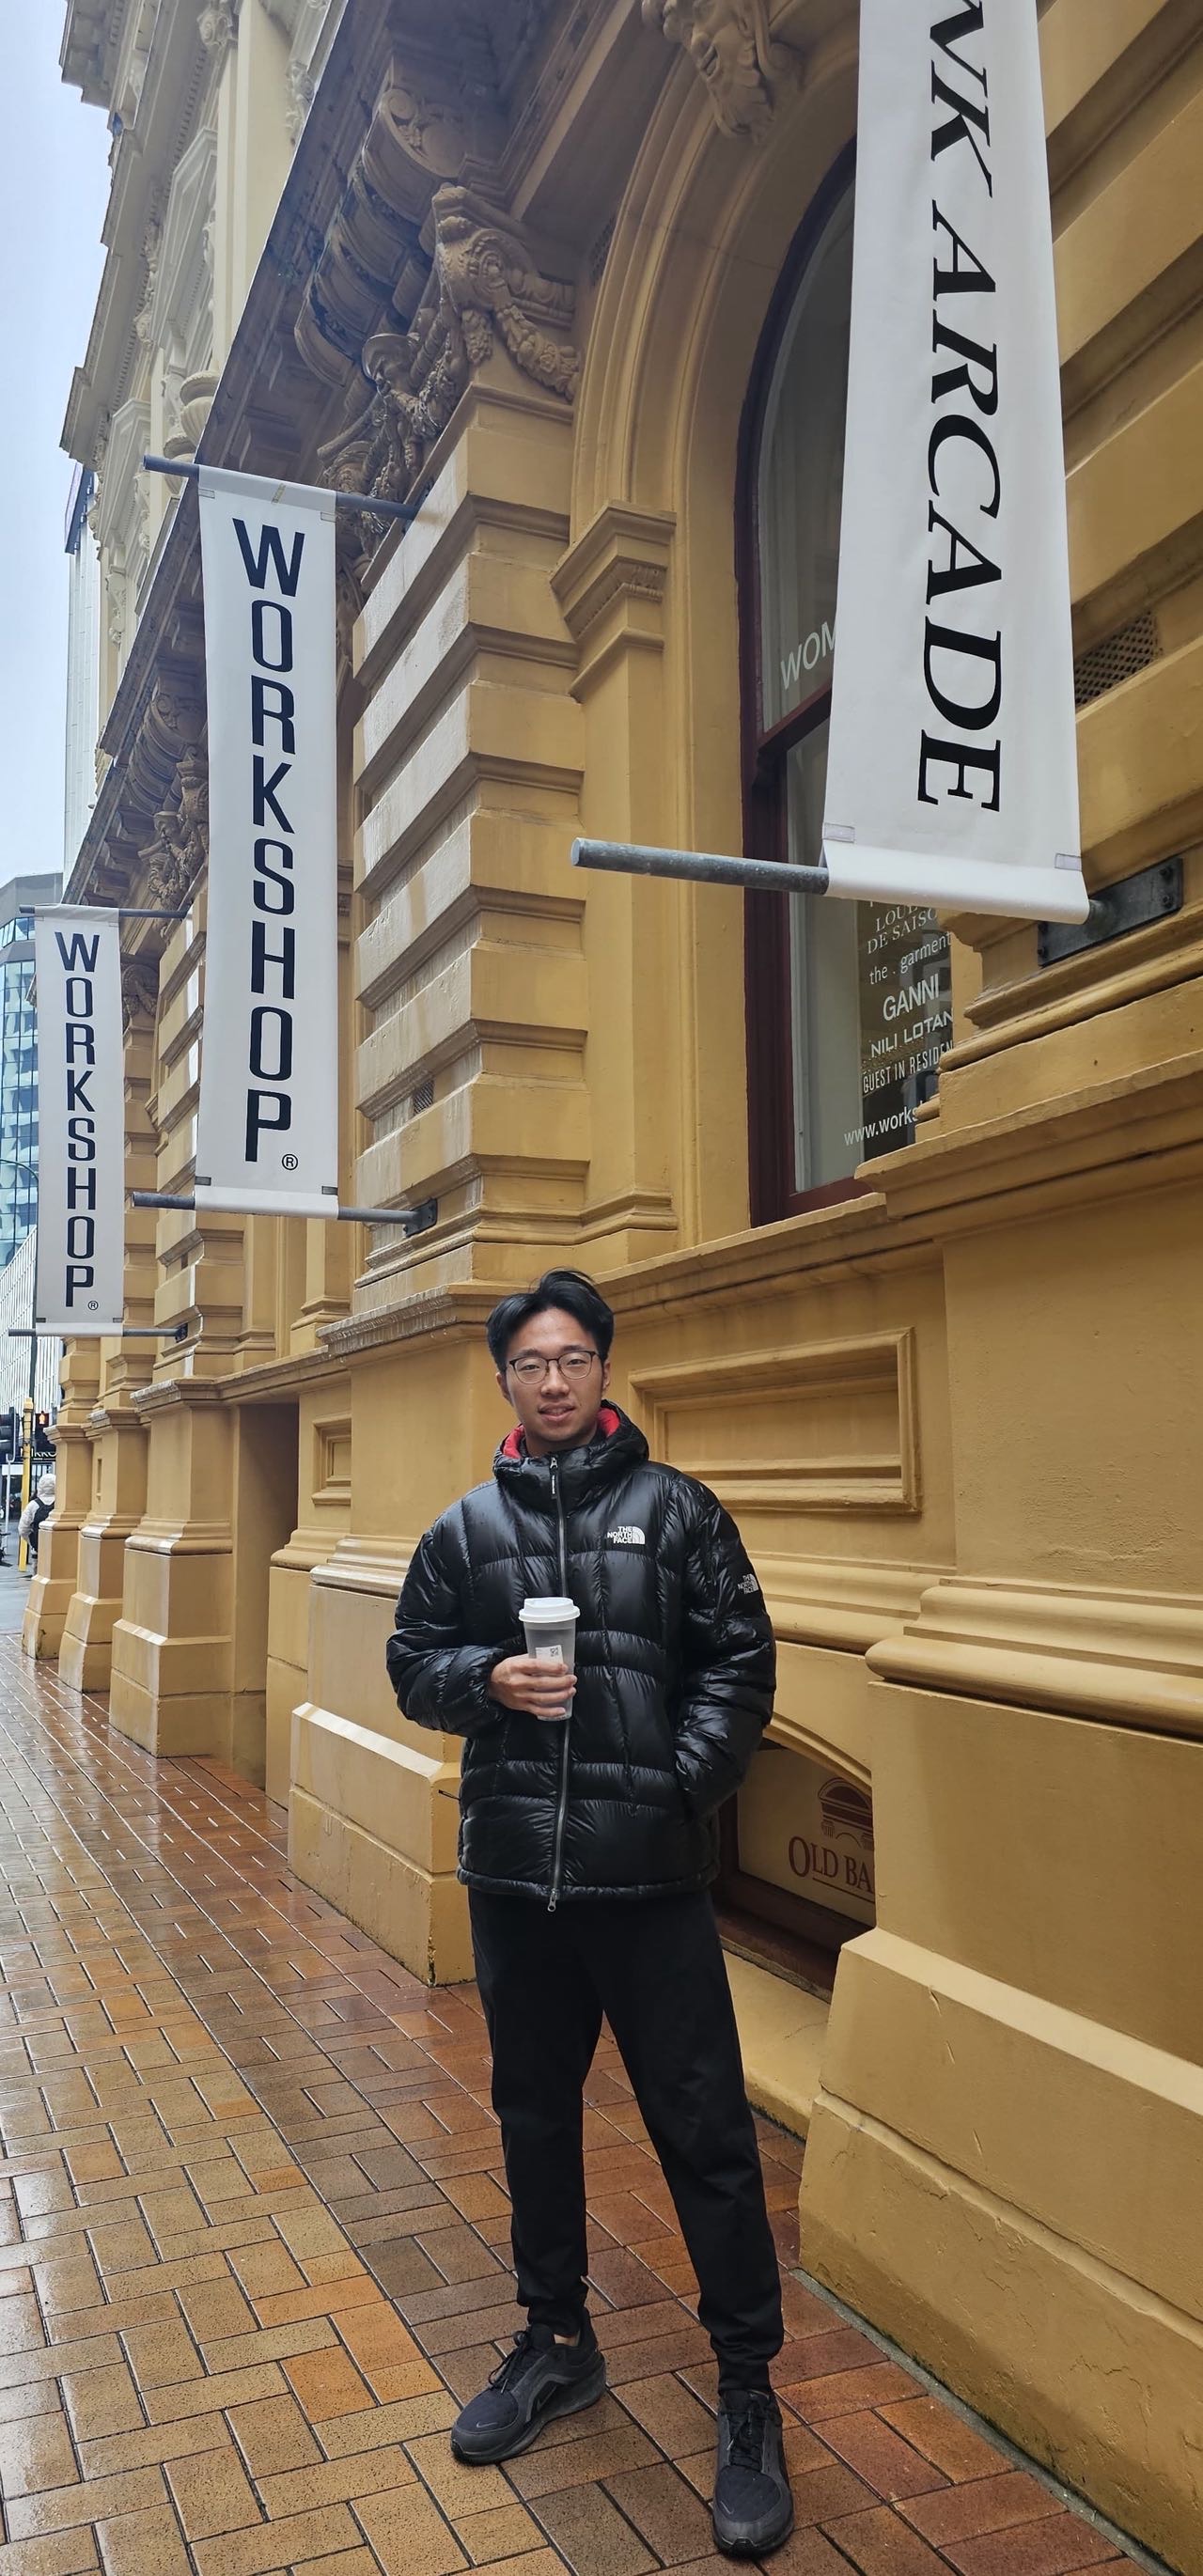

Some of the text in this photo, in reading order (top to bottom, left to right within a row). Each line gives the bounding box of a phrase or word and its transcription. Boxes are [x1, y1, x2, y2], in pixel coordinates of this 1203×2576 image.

[918, 199, 1002, 813] ARCADE
[867, 931, 888, 955] DE
[869, 966, 888, 985] the
[900, 930, 952, 974] garment
[883, 973, 939, 1022] GANNI
[870, 1007, 953, 1058] NILI LOTAN
[863, 1066, 891, 1093] GUEST
[895, 1060, 905, 1081] IN
[788, 1835, 838, 1879] OLD
